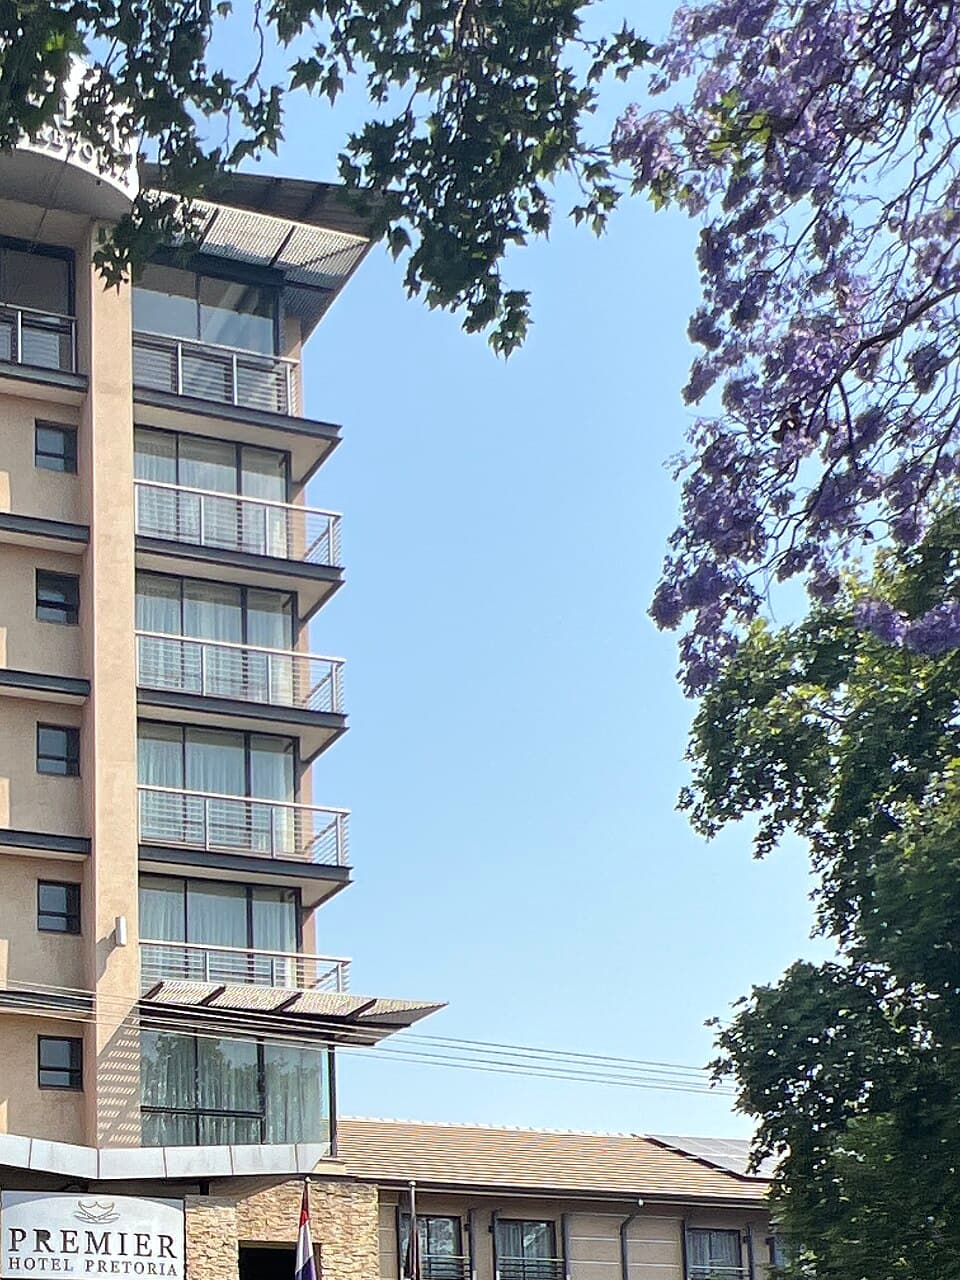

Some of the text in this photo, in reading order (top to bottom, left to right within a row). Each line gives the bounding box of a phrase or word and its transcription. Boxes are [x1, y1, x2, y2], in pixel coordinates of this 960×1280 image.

[8, 1227, 178, 1259] PREMIER
[8, 1256, 178, 1277] HOTEL PRETORIA
